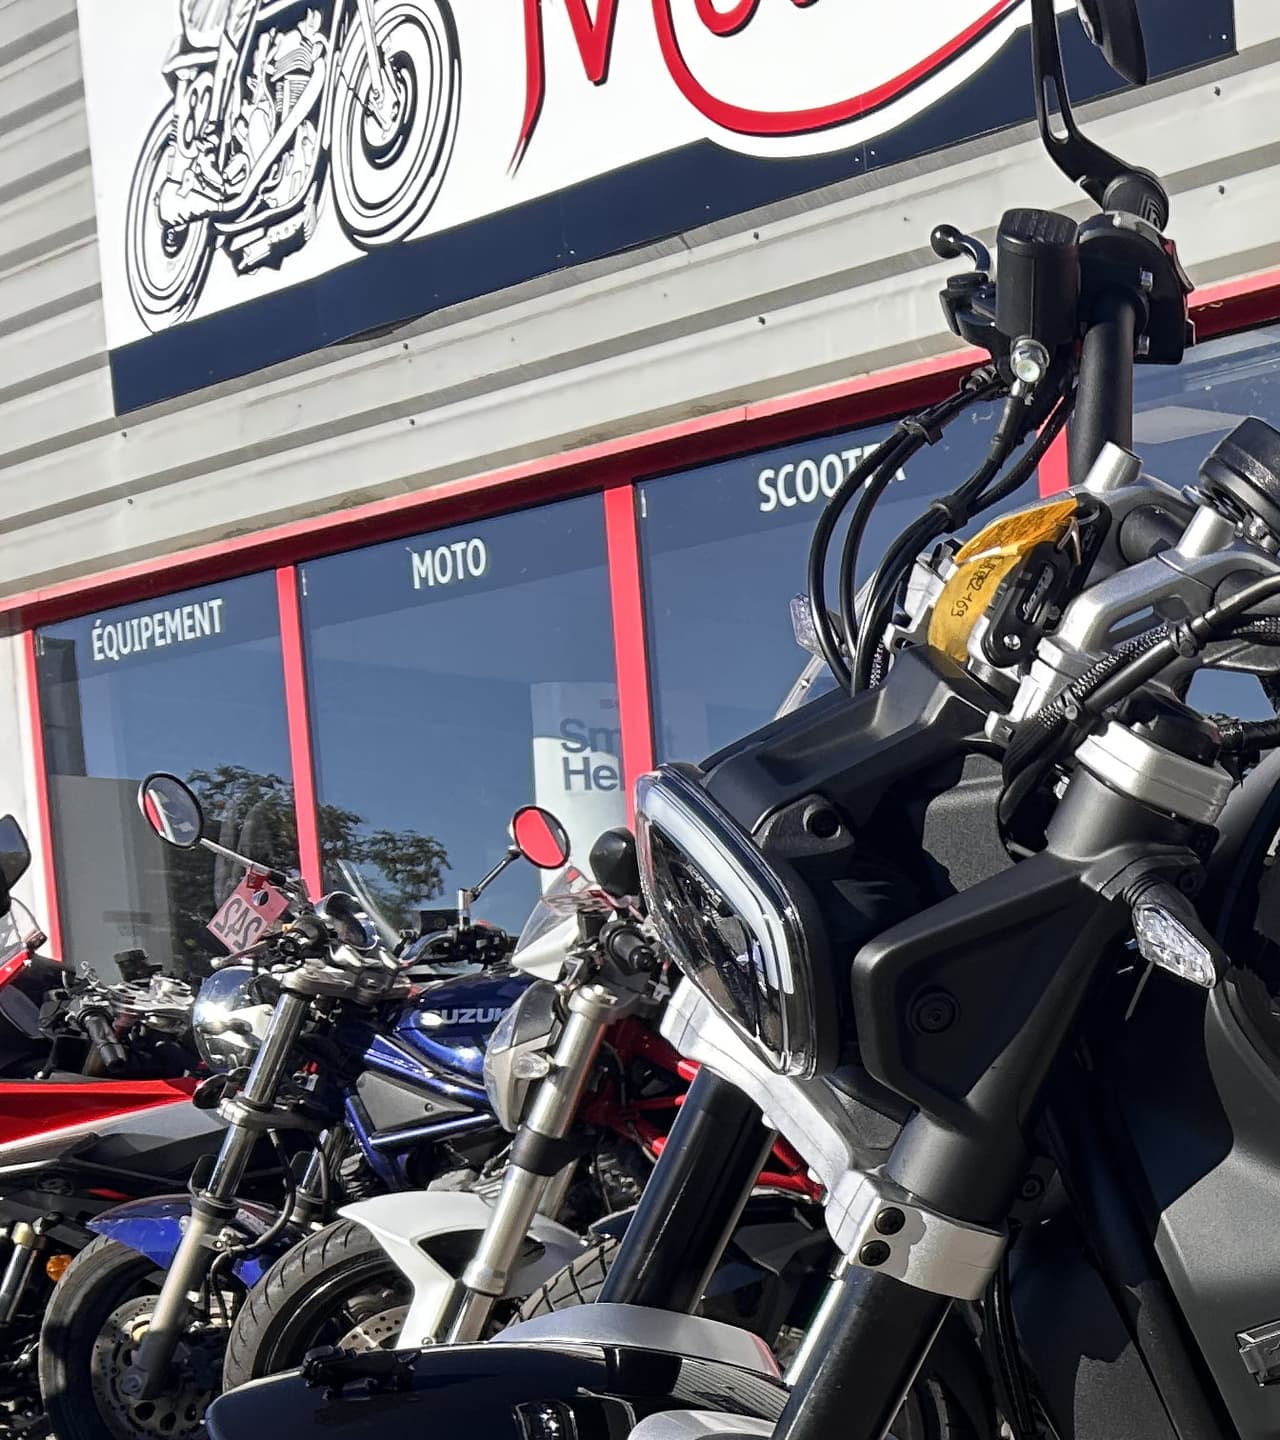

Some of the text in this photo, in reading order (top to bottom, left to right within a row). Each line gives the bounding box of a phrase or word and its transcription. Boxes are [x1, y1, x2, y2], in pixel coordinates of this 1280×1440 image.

[758, 443, 907, 512] SCOOT
[411, 538, 487, 590] MOTO
[91, 598, 224, 661] ÉQUIPEMENT
[562, 756, 627, 791] Hel
